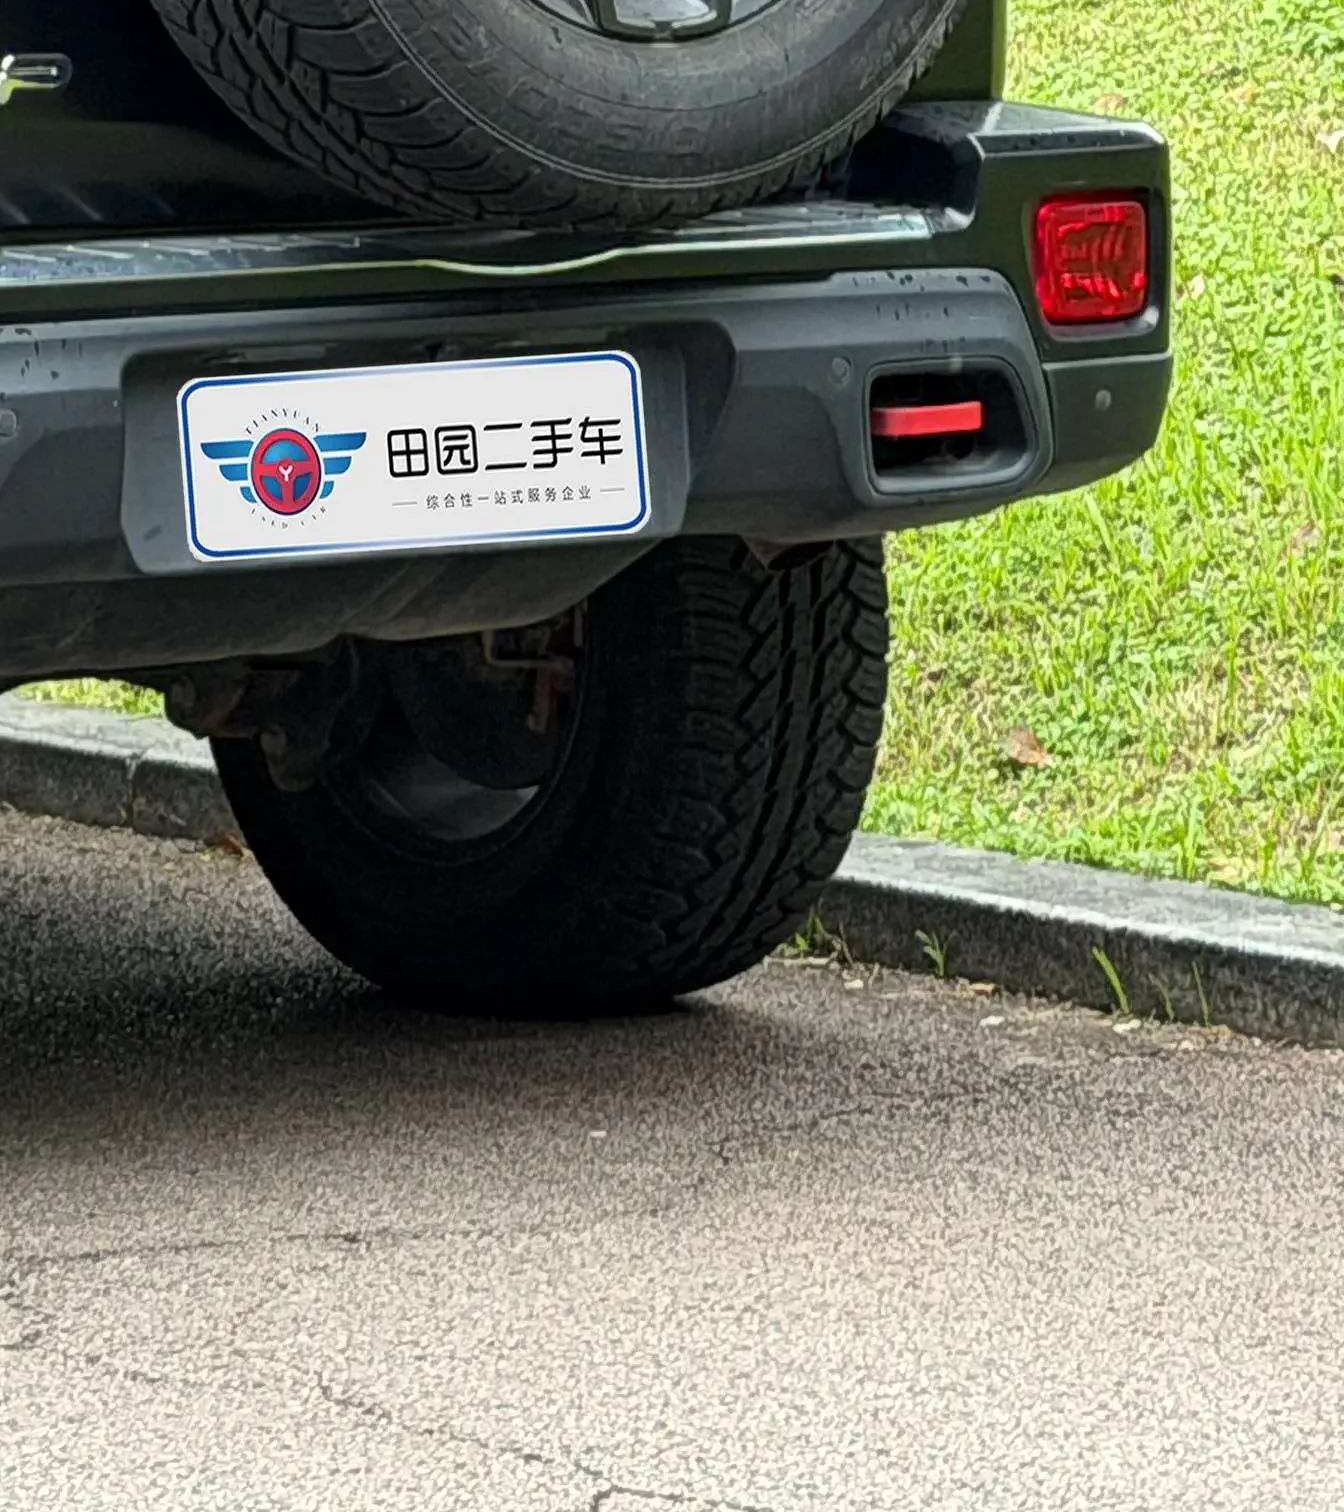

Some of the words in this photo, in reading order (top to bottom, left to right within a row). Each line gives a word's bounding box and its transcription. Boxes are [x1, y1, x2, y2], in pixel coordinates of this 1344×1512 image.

[386, 416, 624, 479] 田园二手车
[425, 484, 592, 511] 综合性一站式服务企业
